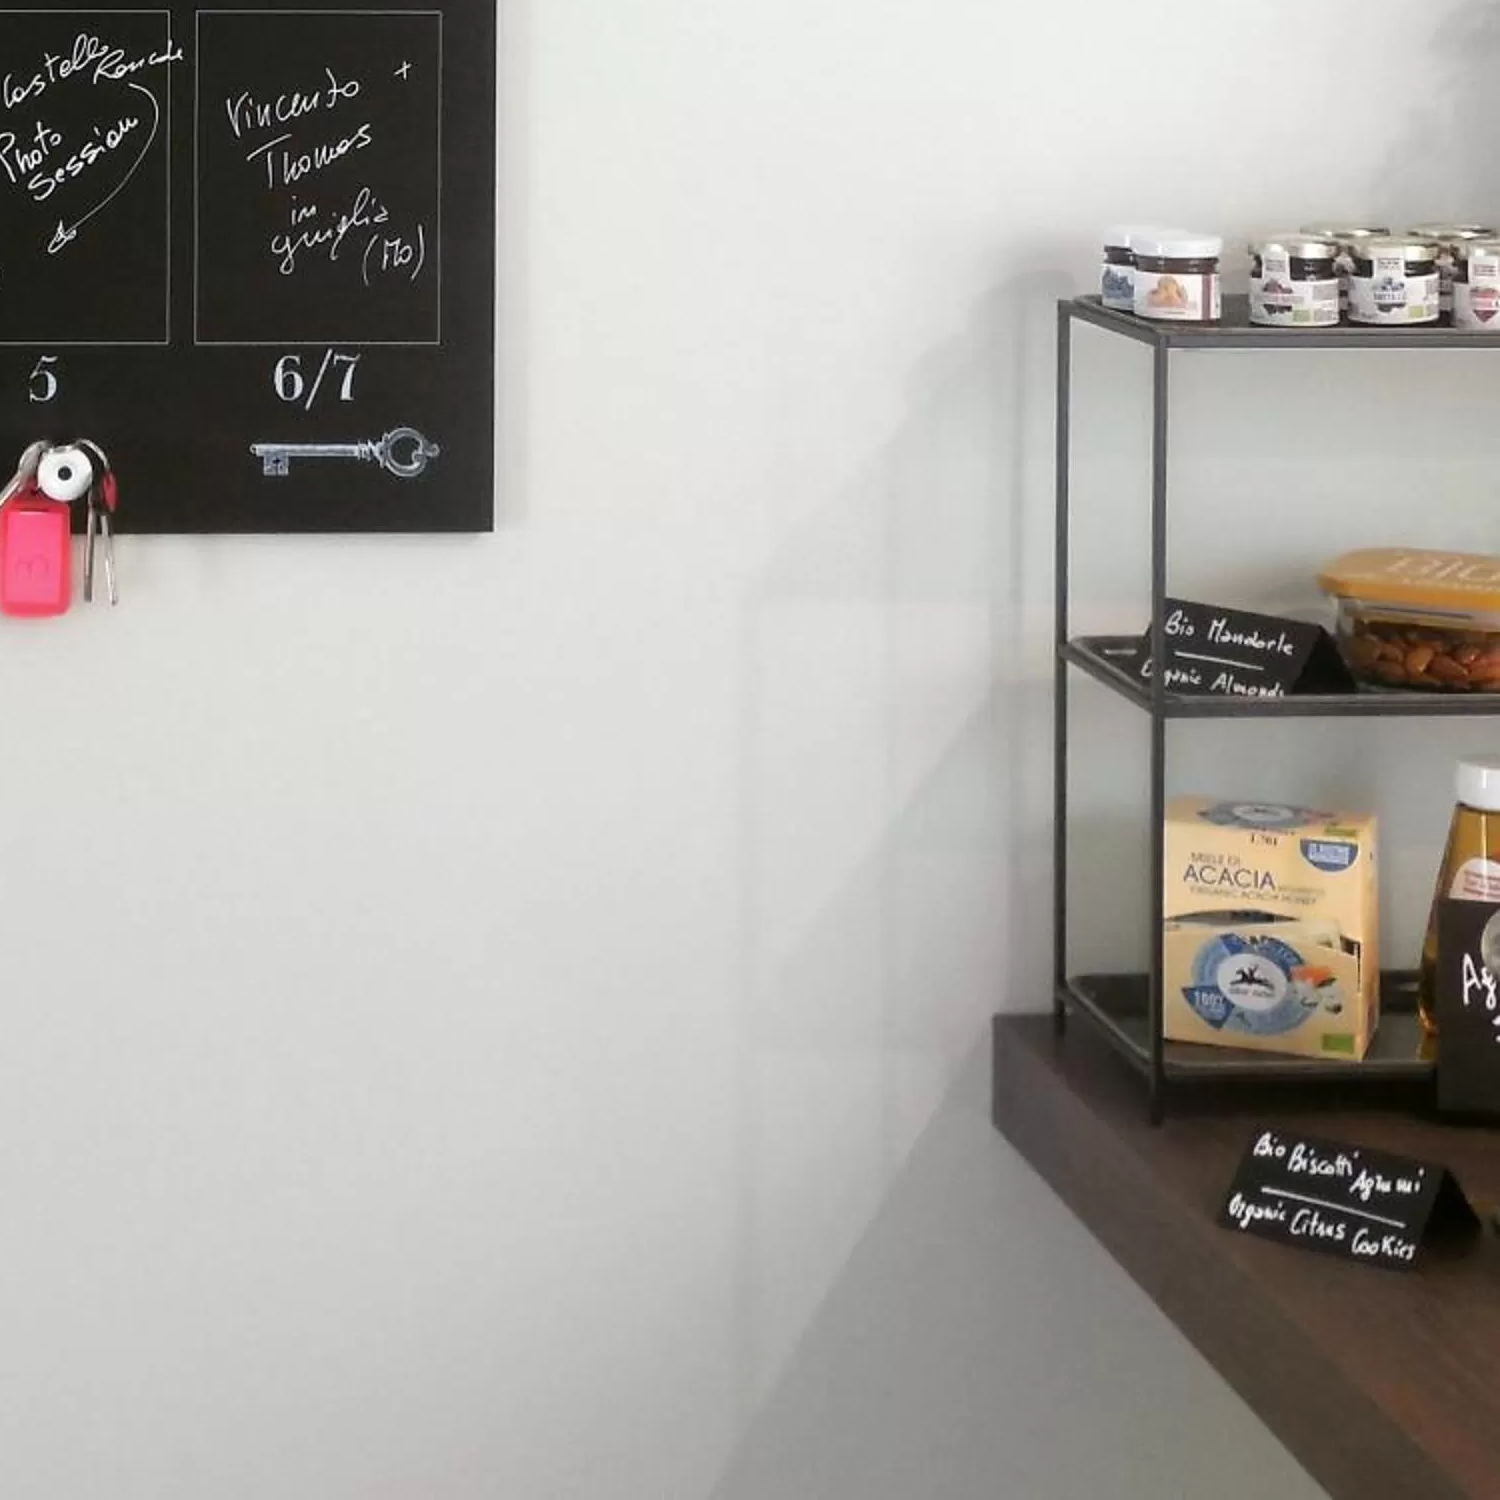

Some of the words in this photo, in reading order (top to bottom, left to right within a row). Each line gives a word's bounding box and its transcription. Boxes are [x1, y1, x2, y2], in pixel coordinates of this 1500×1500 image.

[244, 122, 375, 190] Thomas
[28, 354, 60, 403] 5
[1164, 608, 1195, 637] Bio
[1140, 658, 1202, 687] Oganic
[1183, 864, 1276, 890] ACACIA
[1253, 1131, 1286, 1156] Bio
